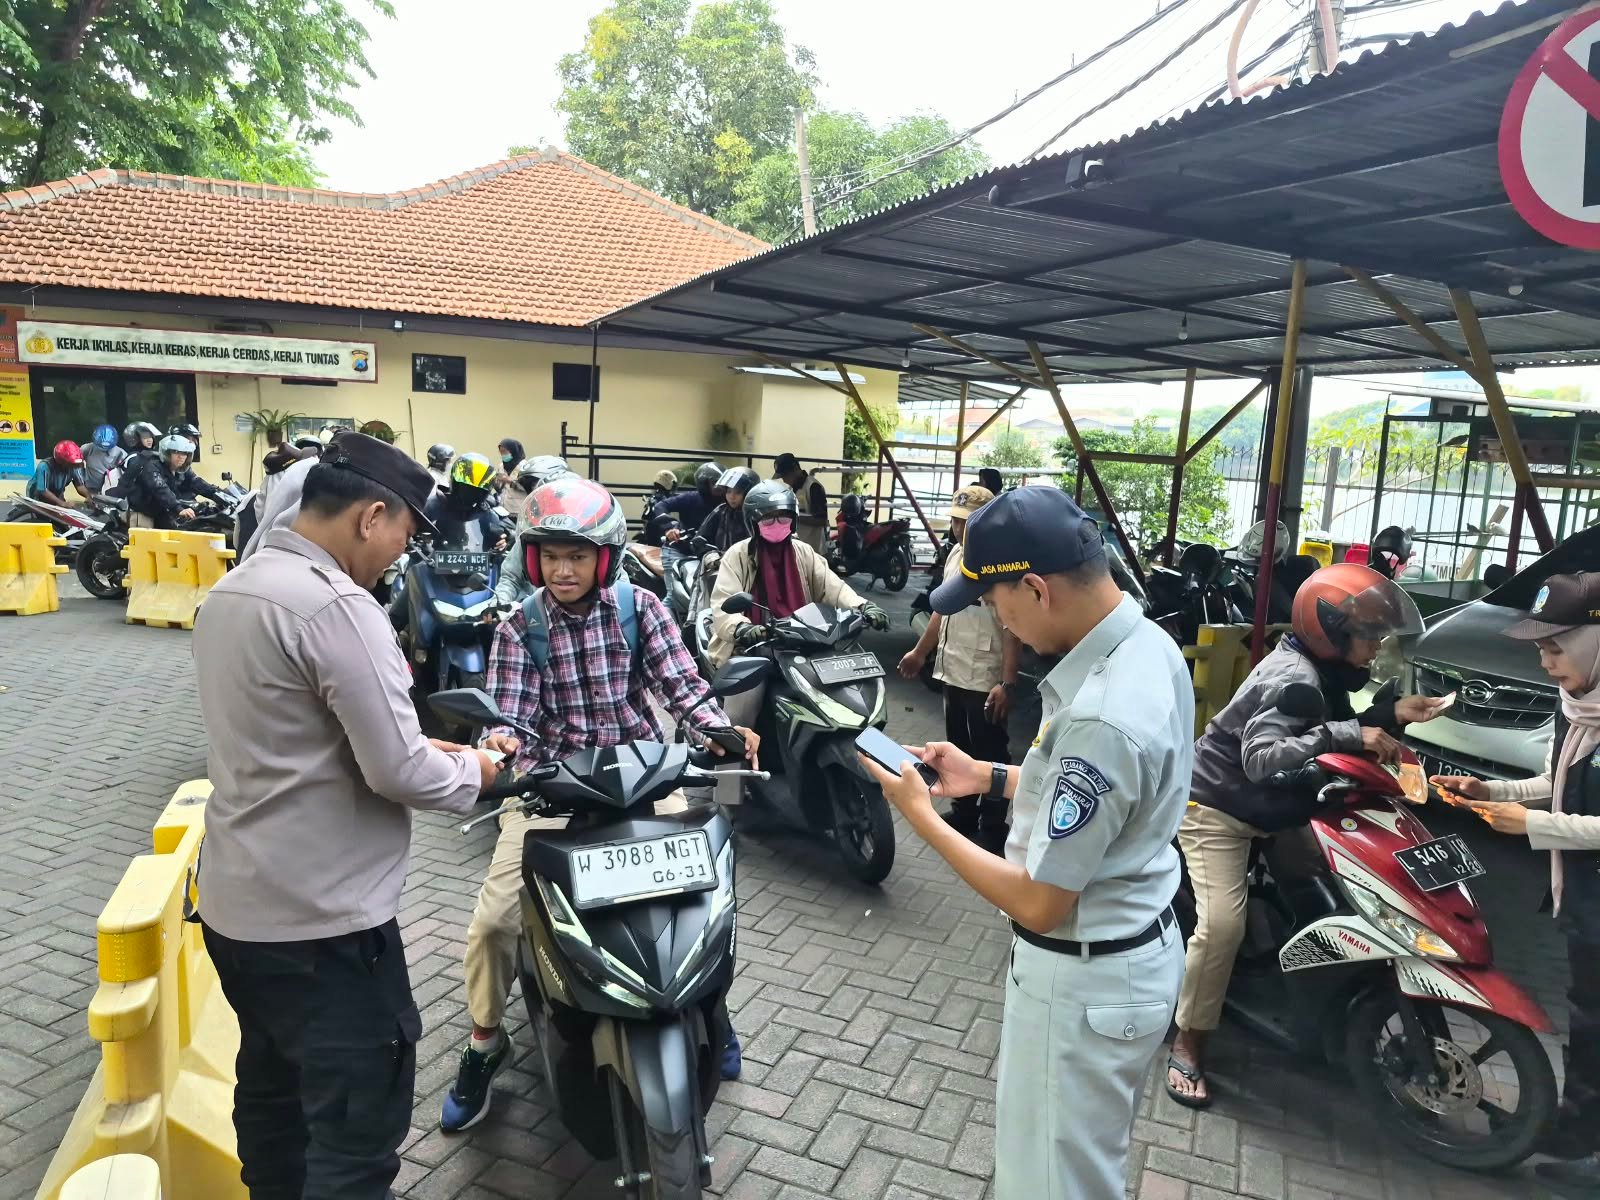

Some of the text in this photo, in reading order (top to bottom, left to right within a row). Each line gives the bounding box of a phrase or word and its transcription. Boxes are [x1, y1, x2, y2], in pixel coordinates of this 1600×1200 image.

[56, 337, 90, 351] KERJA
[305, 352, 340, 366] TUNTAS
[438, 554, 444, 564] W
[447, 554, 467, 564] 2243
[980, 560, 1031, 575] JASA RAHARJA
[831, 659, 857, 670] 2003
[577, 837, 701, 873] W 3988 NGT
[1413, 843, 1449, 867] 5416
[1338, 930, 1371, 954] YAMAHA
[539, 945, 563, 991] HONDA
